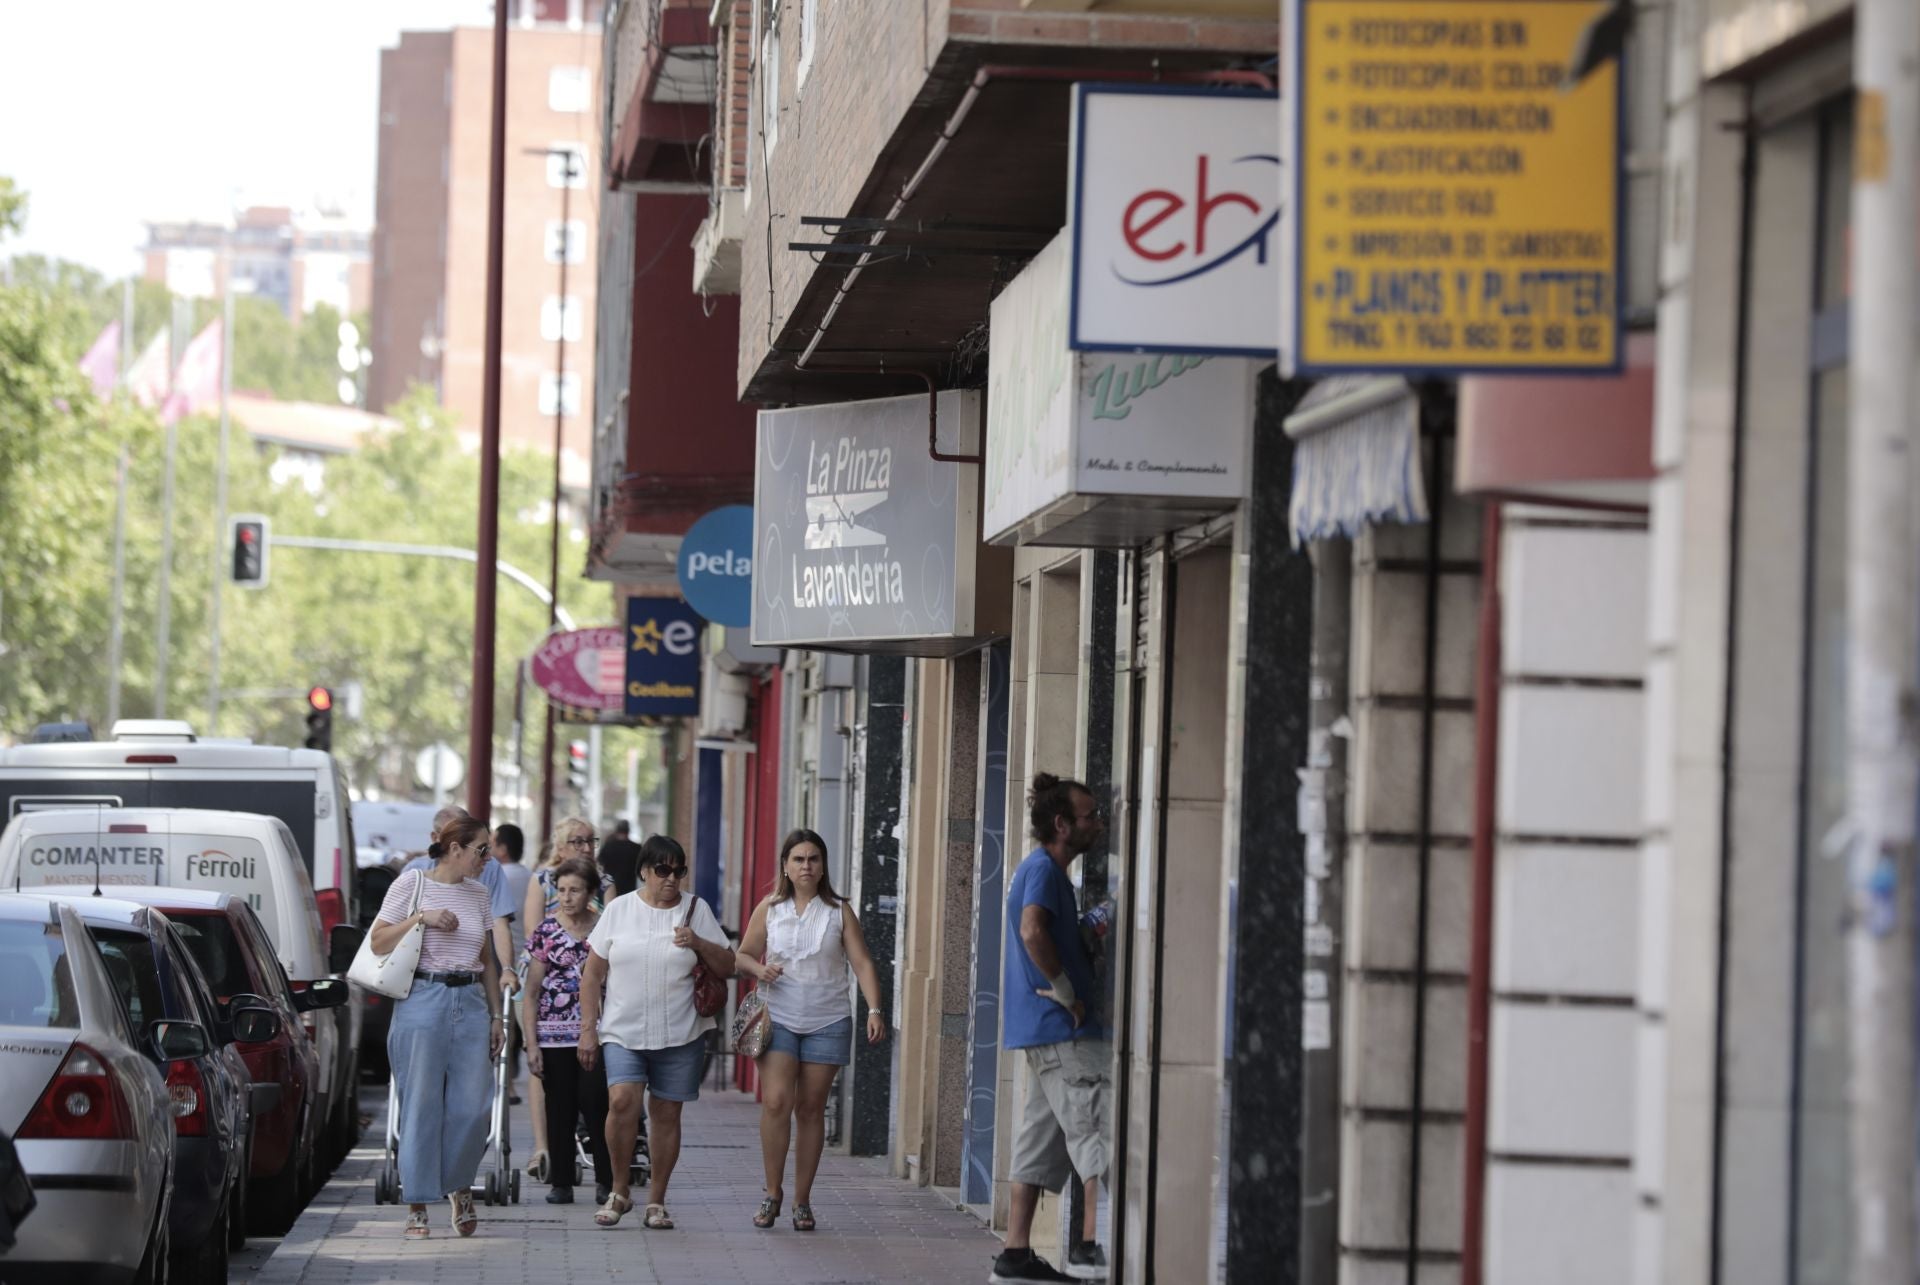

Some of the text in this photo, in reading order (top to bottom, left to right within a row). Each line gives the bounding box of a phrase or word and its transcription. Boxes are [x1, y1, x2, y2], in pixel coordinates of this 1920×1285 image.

[1350, 21, 1483, 48] FOTOCOPIAS
[1350, 61, 1563, 90] FOTOCOPIAS COLOR
[1349, 101, 1553, 134] ENCUADERNACIÓN
[1349, 143, 1523, 176] PLASTIFICACIÓN
[1348, 188, 1497, 217] SERVICIO FAX
[1349, 228, 1606, 260] IMPRESIÓN DE CAMISETAS
[1331, 267, 1612, 319] PLANOS Y PLOTTER
[806, 436, 892, 494] La Pinza
[1086, 459, 1120, 471] Moda
[1137, 460, 1227, 477] Complementos
[793, 547, 904, 608] Lavandería
[663, 619, 695, 655] e
[30, 847, 165, 866] COMANTER
[44, 874, 147, 886] MANTENMIENTOS
